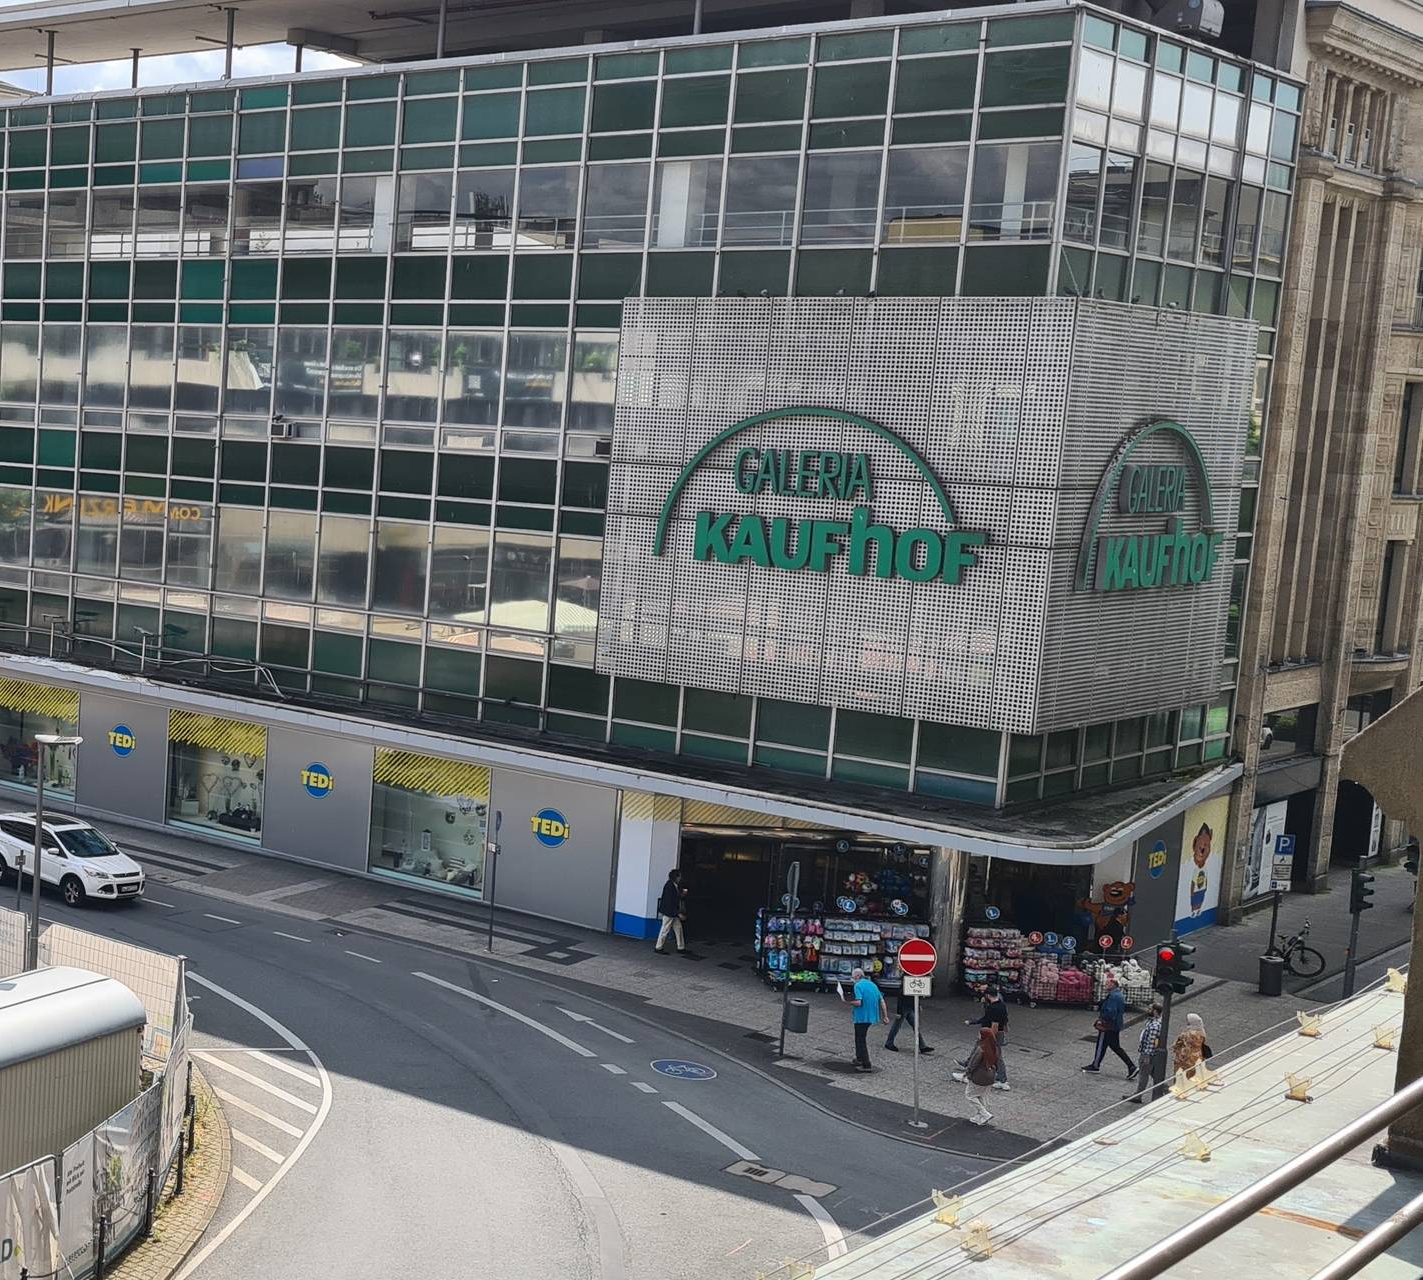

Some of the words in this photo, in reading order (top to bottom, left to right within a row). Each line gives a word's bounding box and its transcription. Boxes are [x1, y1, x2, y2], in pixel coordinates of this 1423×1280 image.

[734, 447, 875, 500] GALERIA
[1122, 465, 1186, 515] GALERIA
[109, 731, 136, 749] TEDi
[301, 769, 334, 791] TEDi
[531, 815, 569, 840] TEDi
[1279, 837, 1290, 852] P
[1149, 851, 1167, 868] TEDi
